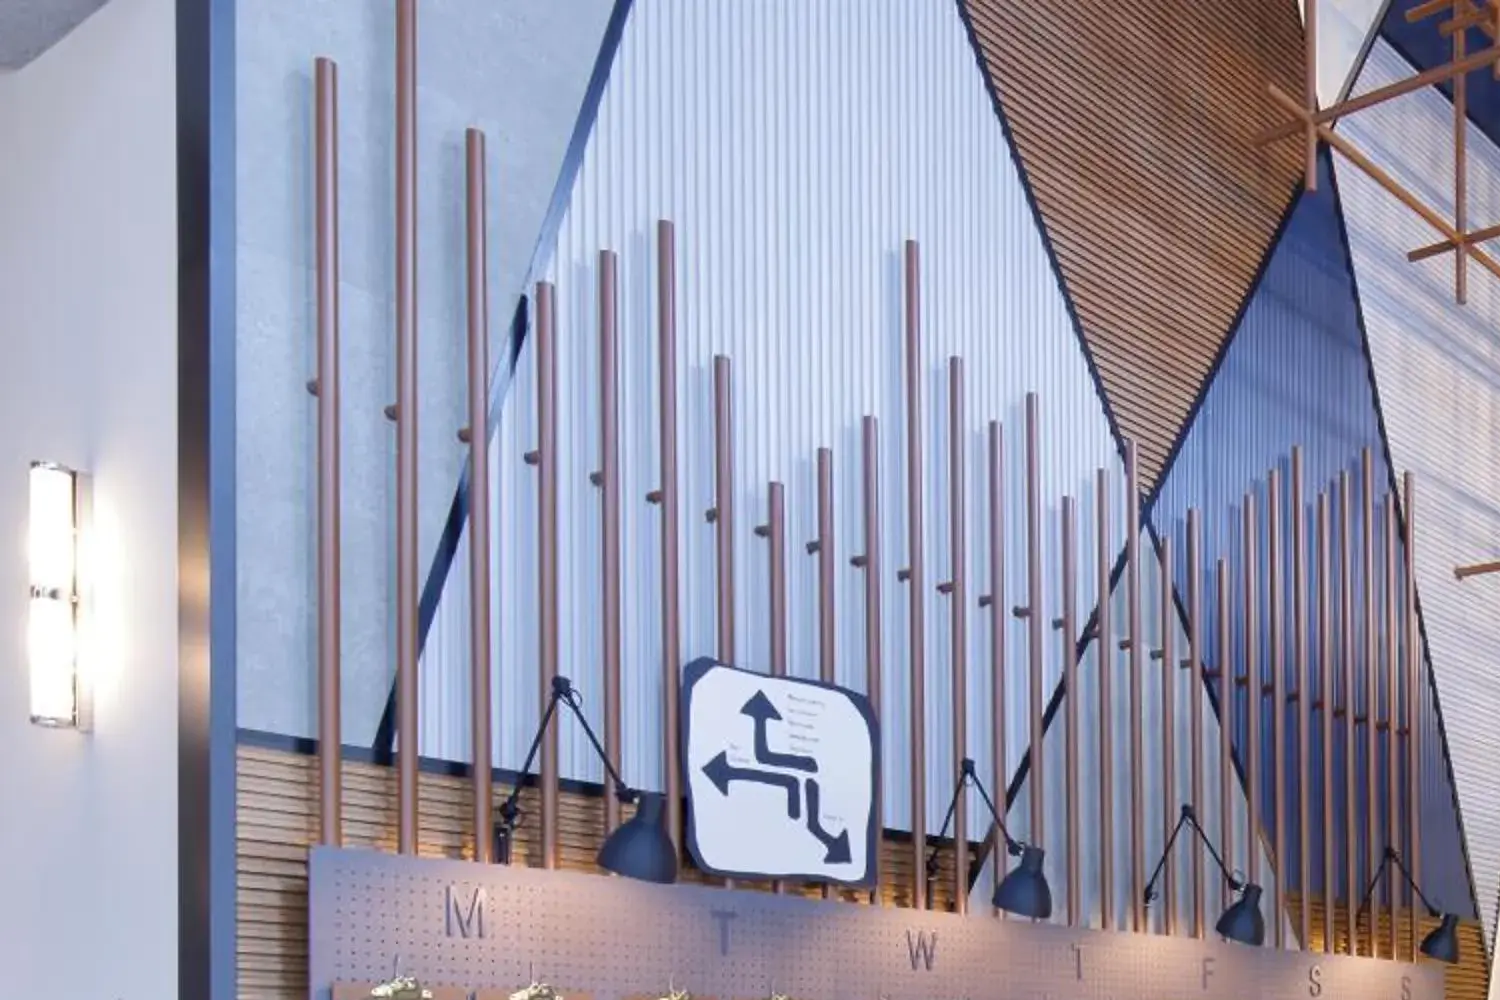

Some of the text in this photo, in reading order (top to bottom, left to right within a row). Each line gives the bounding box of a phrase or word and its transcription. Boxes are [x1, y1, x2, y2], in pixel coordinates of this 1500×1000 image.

[444, 884, 487, 939] M
[711, 909, 738, 956] T
[905, 929, 937, 972] W
[1071, 942, 1083, 982] T
[1202, 957, 1216, 991] F
[1308, 964, 1322, 998] S
